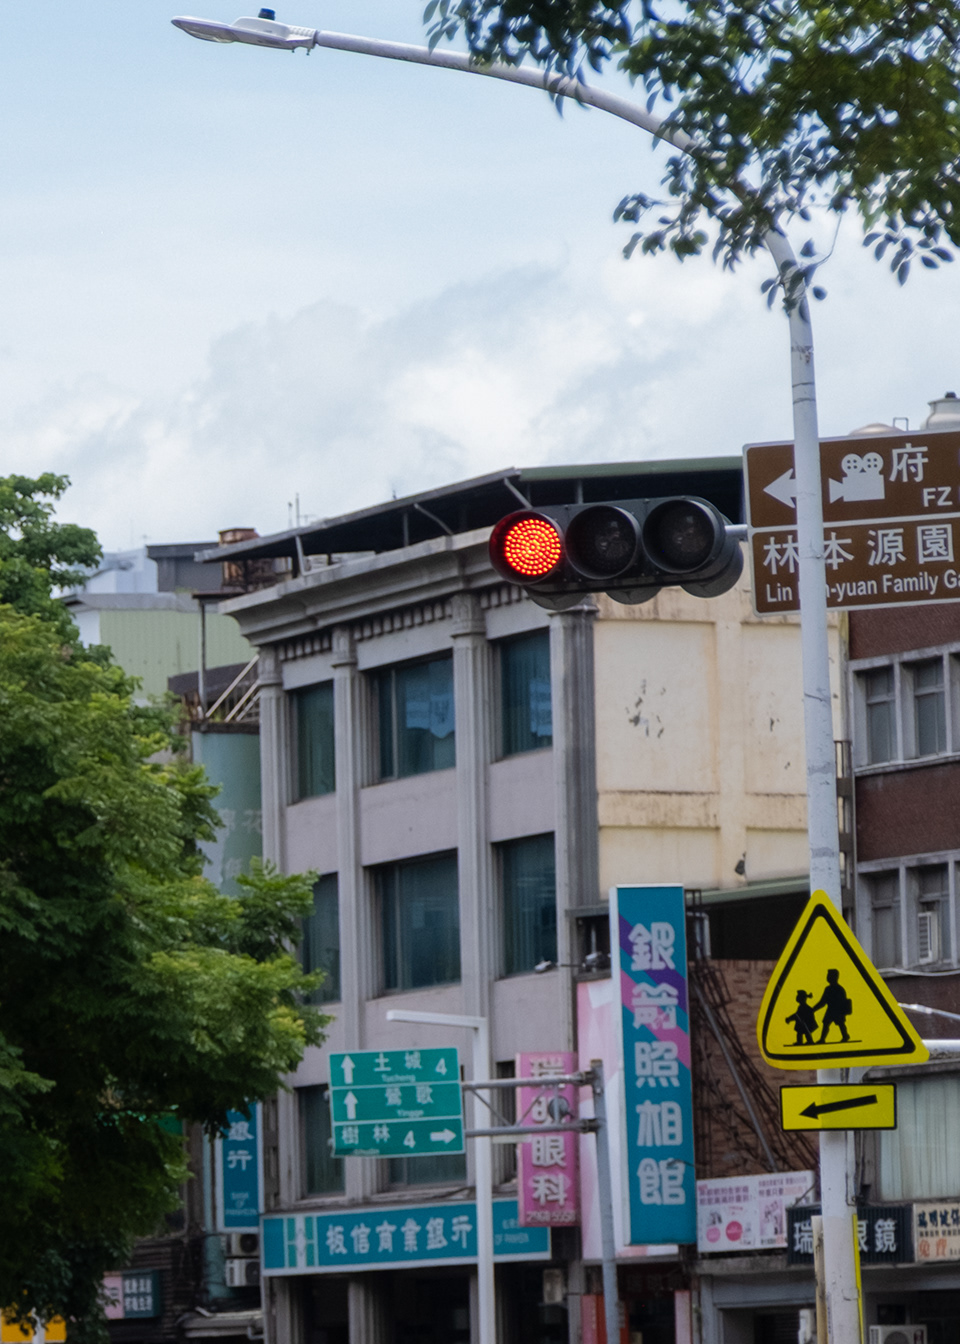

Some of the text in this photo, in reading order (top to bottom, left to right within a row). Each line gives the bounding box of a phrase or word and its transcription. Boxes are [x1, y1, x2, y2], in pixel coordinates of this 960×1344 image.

[923, 486, 953, 507] FZ
[766, 583, 793, 603] Lin
[882, 571, 939, 596] Family
[373, 1051, 448, 1076] 土城 4
[628, 921, 686, 1206] 銀箭照相館
[342, 1124, 416, 1149] 樹林 4
[326, 1215, 473, 1256] 板信商業銀行
